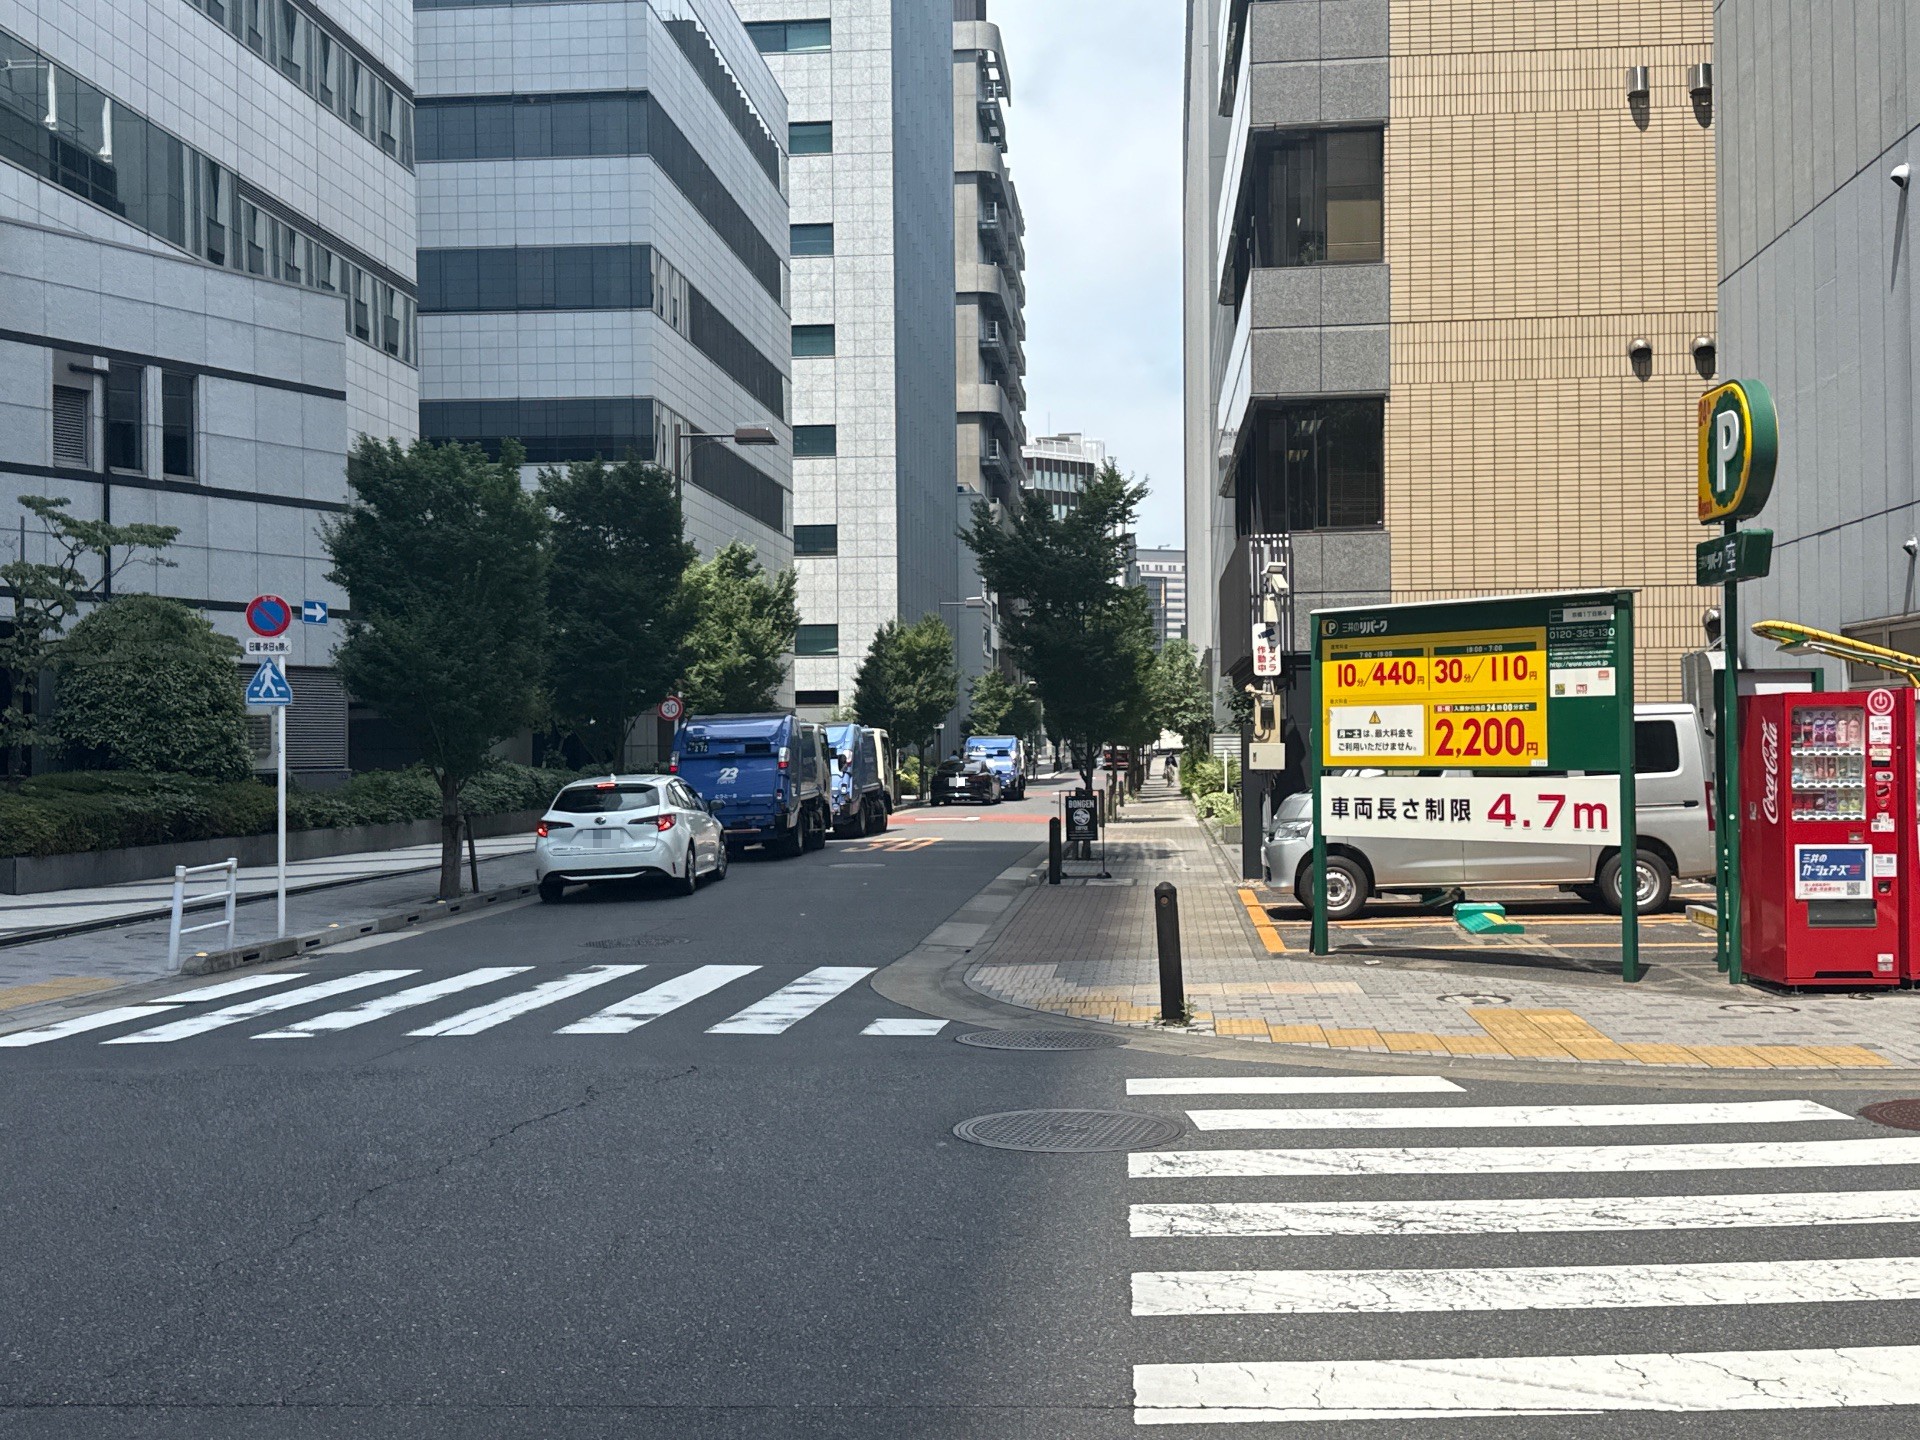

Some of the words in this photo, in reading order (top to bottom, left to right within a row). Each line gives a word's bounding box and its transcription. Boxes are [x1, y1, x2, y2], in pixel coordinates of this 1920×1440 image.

[1716, 409, 1740, 493] P
[1342, 620, 1388, 634] 三井のリパーク
[1549, 627, 1615, 640] 0120-325-130
[1257, 645, 1267, 672] 作動中
[1268, 646, 1277, 672] カメラ
[663, 702, 677, 714] 30
[1435, 717, 1539, 758] 2,200円
[1338, 742, 1417, 752] ご利用いただけません。
[720, 767, 739, 779] 23
[1330, 796, 1472, 823] 車両長さ制限
[1487, 793, 1609, 831] 4.7m
[1801, 853, 1828, 863] 三井の
